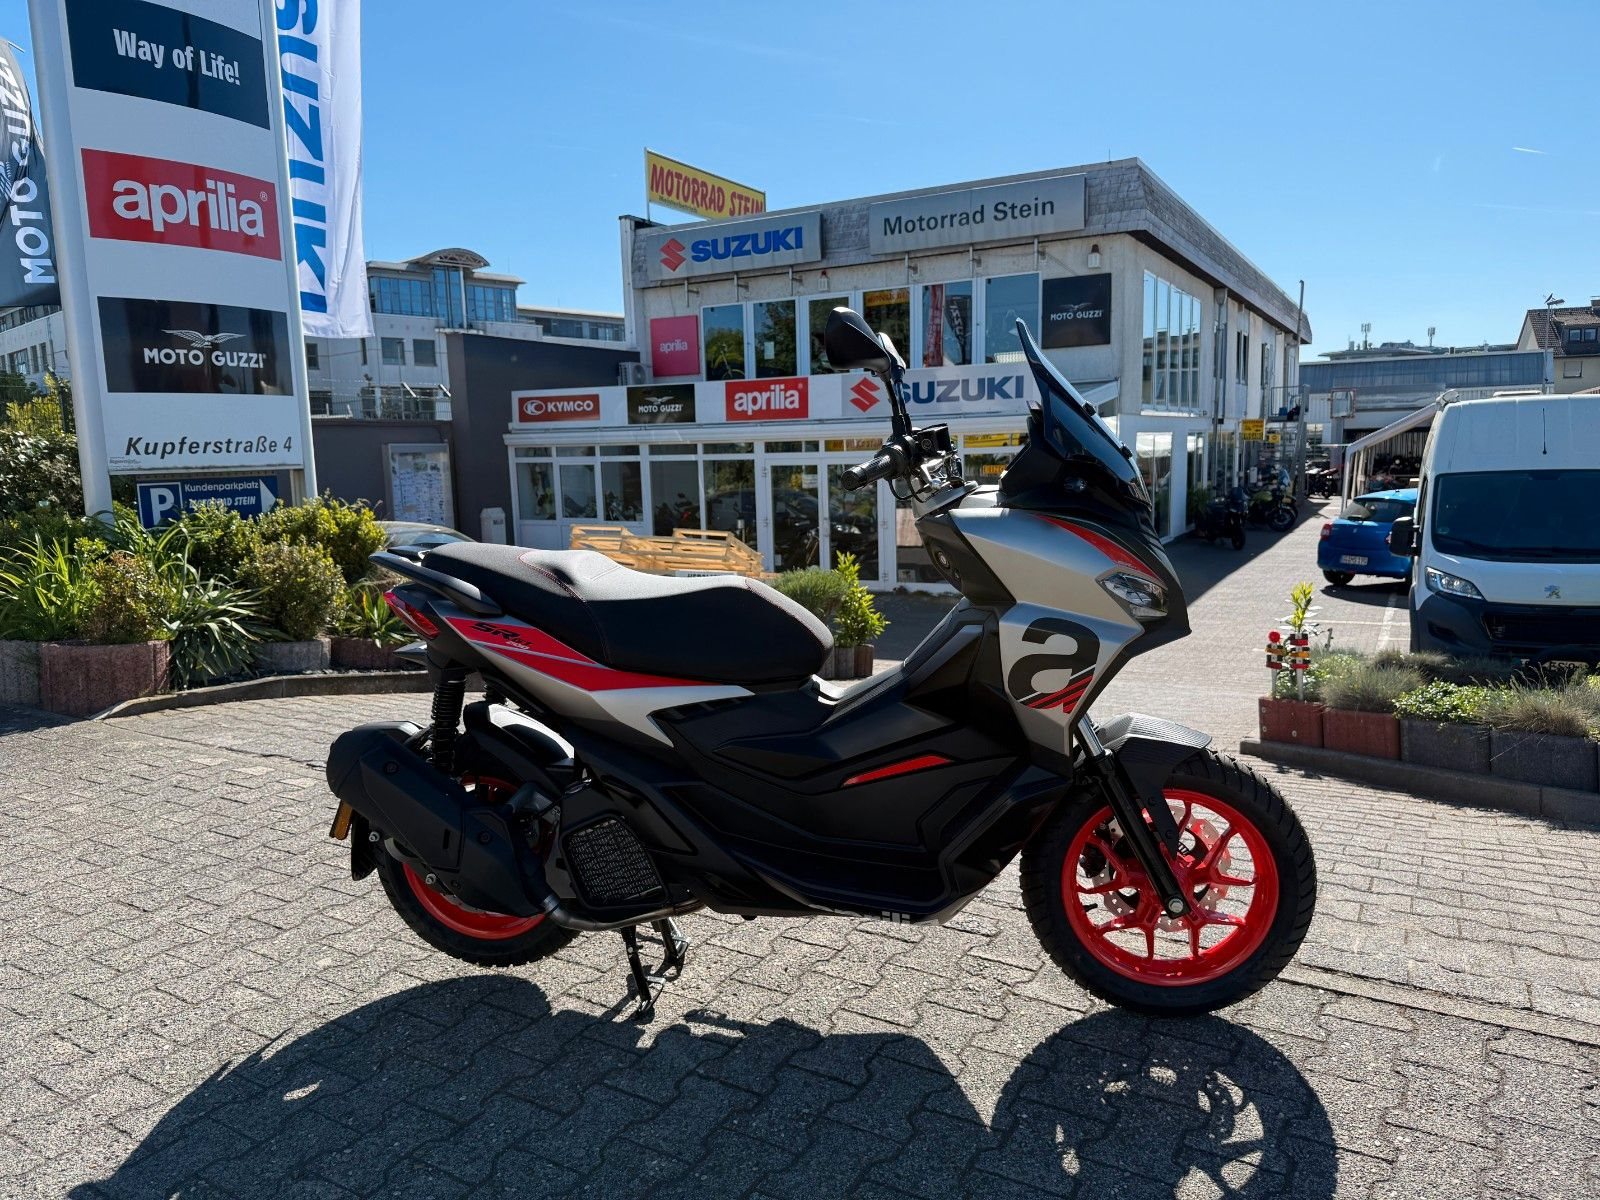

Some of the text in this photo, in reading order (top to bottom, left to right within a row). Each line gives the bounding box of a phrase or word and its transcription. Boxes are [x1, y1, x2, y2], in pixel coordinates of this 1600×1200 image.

[112, 28, 241, 86] Way of Life!
[650, 163, 726, 214] MOTORRAD
[112, 179, 265, 238] aprilia
[883, 196, 1055, 237] Motorrad Stein
[10, 176, 57, 284] MOTO
[690, 226, 803, 263] SUZUKI
[1050, 309, 1102, 321] MOTO GUZZI
[143, 347, 264, 369] MOTO GUZZI
[660, 338, 688, 354] aprilia
[547, 399, 594, 413] KYMCO
[638, 403, 683, 414] MOTO GUZZI
[734, 383, 800, 416] aprilia
[125, 435, 293, 460] Kupferstraße 4
[184, 481, 259, 492] Kundenparkplatz
[233, 495, 256, 506] STEIN
[149, 487, 175, 526] P
